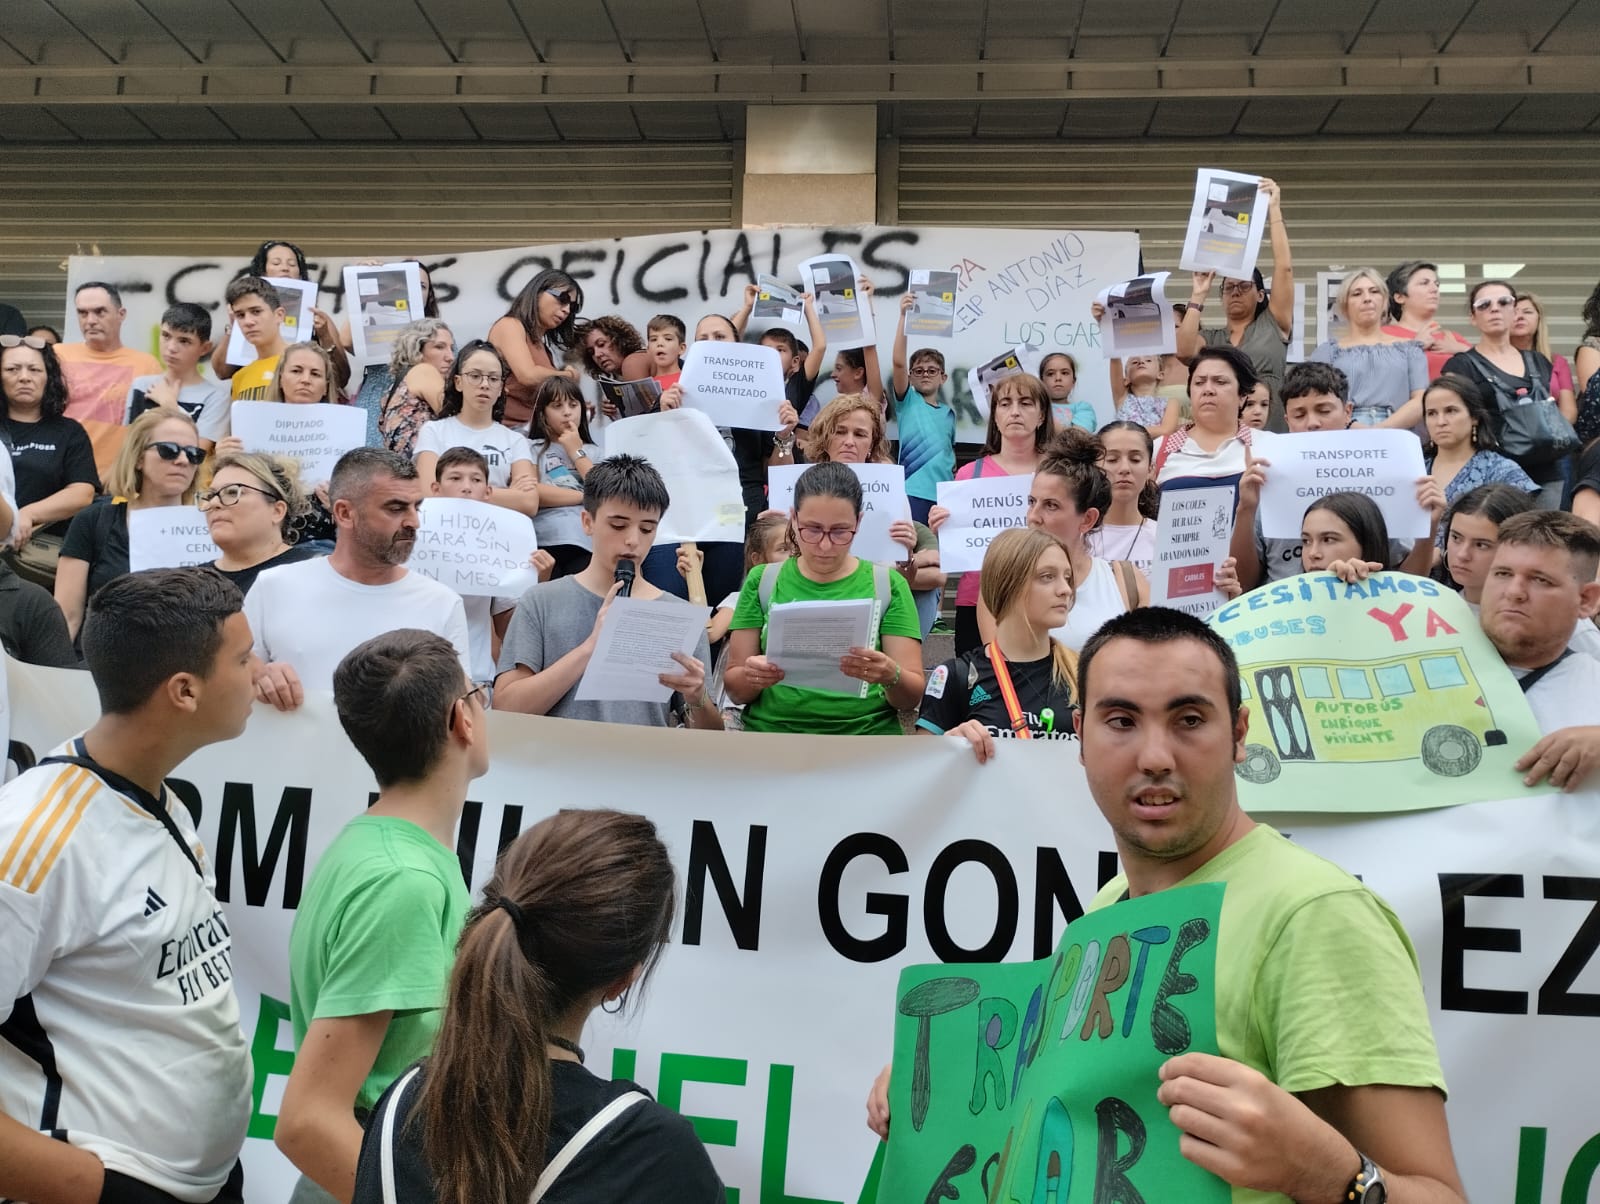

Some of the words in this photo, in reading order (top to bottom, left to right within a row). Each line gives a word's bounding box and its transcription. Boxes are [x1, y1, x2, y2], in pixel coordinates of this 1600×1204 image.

[987, 232, 1085, 301] ANTONIO
[1004, 321, 1047, 347] LOS
[703, 356, 765, 370] TRANSPORTE
[712, 371, 754, 383] ESCOLAR
[697, 384, 767, 398] GARANTIZADO
[275, 419, 325, 429] DIPUTADO
[287, 447, 321, 457] CENTRO
[1301, 449, 1388, 460] TRANSPORTE
[1316, 467, 1375, 478] ESCOLAR
[972, 493, 1023, 508] MENÚS
[441, 512, 497, 536] HIJO/A
[1171, 515, 1202, 528] RURALES
[1171, 531, 1200, 545] SIEMPRE
[1160, 546, 1210, 561] ABANDONADOS
[455, 569, 500, 587] MES
[1367, 602, 1459, 642] YA
[177, 967, 205, 1006] FLY
